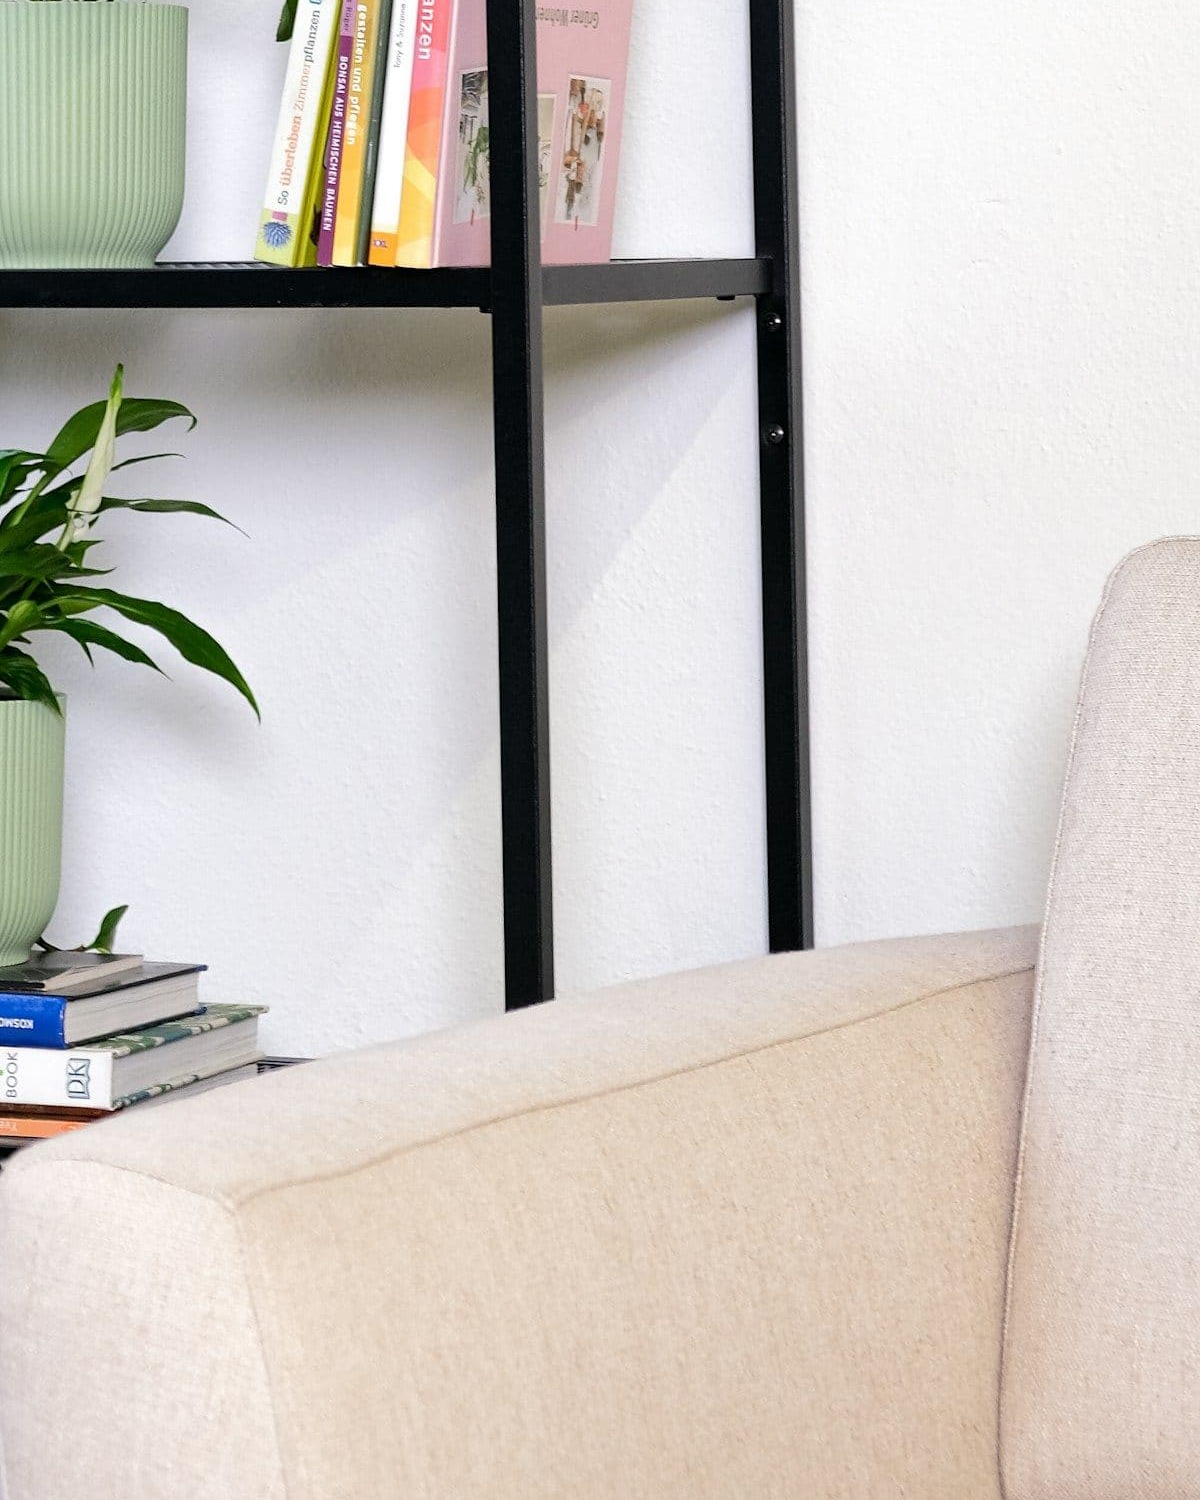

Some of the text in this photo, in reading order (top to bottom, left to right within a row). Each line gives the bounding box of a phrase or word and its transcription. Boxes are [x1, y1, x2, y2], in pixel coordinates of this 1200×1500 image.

[355, 3, 368, 63] gestalten
[293, 9, 321, 112] Zimmerpflanzen
[337, 56, 349, 94] BONSAI
[351, 68, 363, 92] und
[393, 50, 405, 68] Tony
[334, 98, 345, 117] AUS
[346, 96, 360, 145] pflegen
[279, 116, 303, 186] überleben
[327, 120, 343, 185] HEIMISCHEN
[278, 190, 289, 205] So
[5, 1051, 19, 1098] BOOK
[67, 1059, 90, 1099] DK
